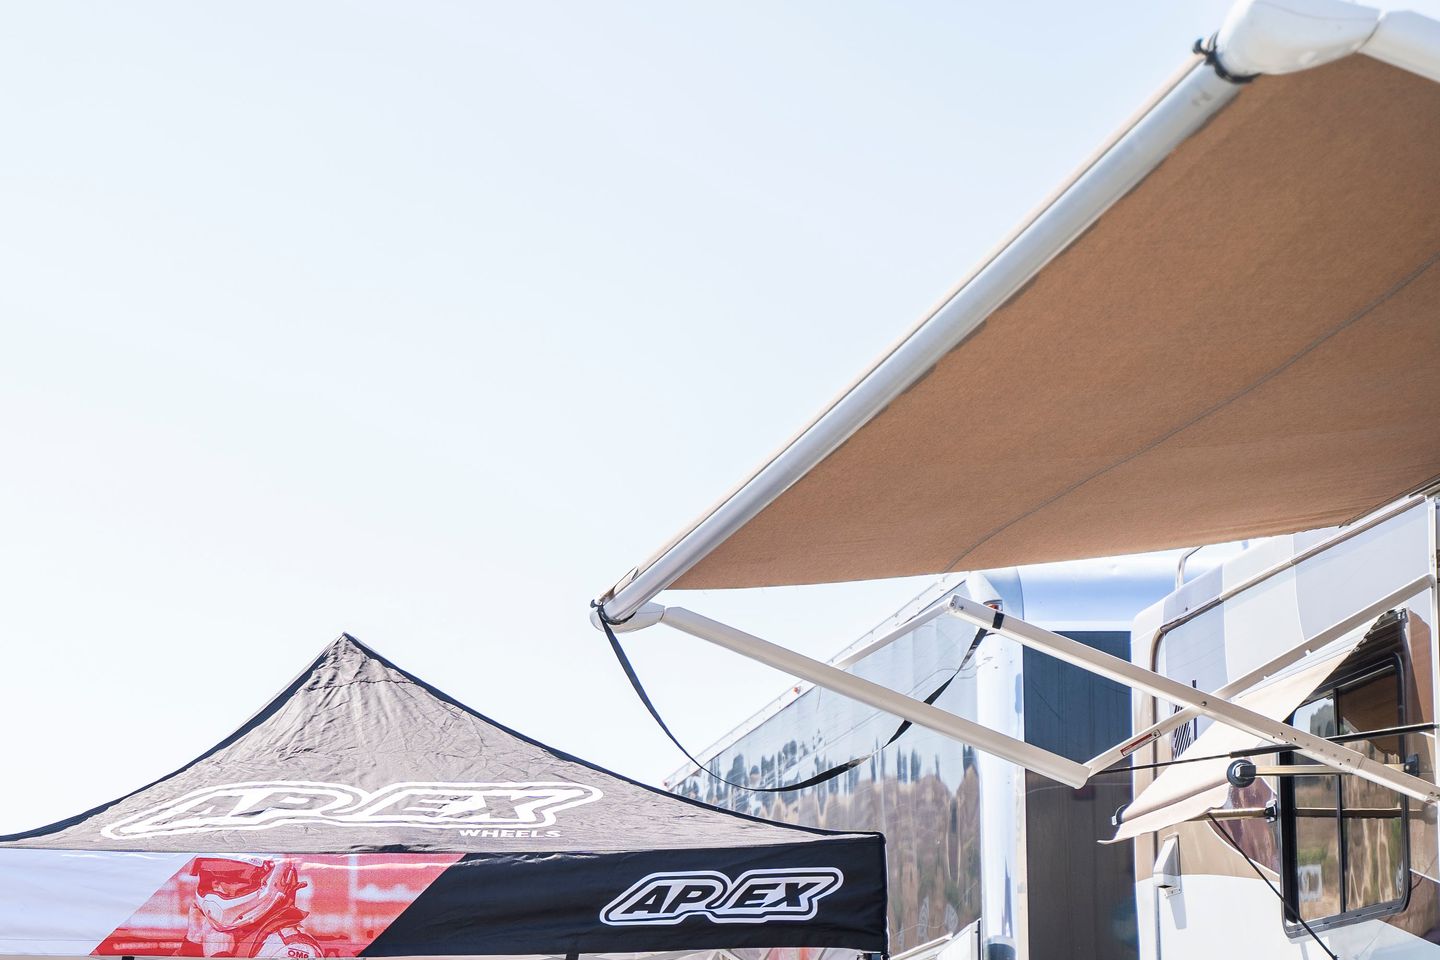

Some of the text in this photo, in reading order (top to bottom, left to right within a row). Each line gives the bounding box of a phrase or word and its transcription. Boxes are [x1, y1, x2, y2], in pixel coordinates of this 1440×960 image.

[108, 784, 597, 834] APEX
[459, 829, 562, 838] WHEELS
[607, 872, 835, 920] APEX
